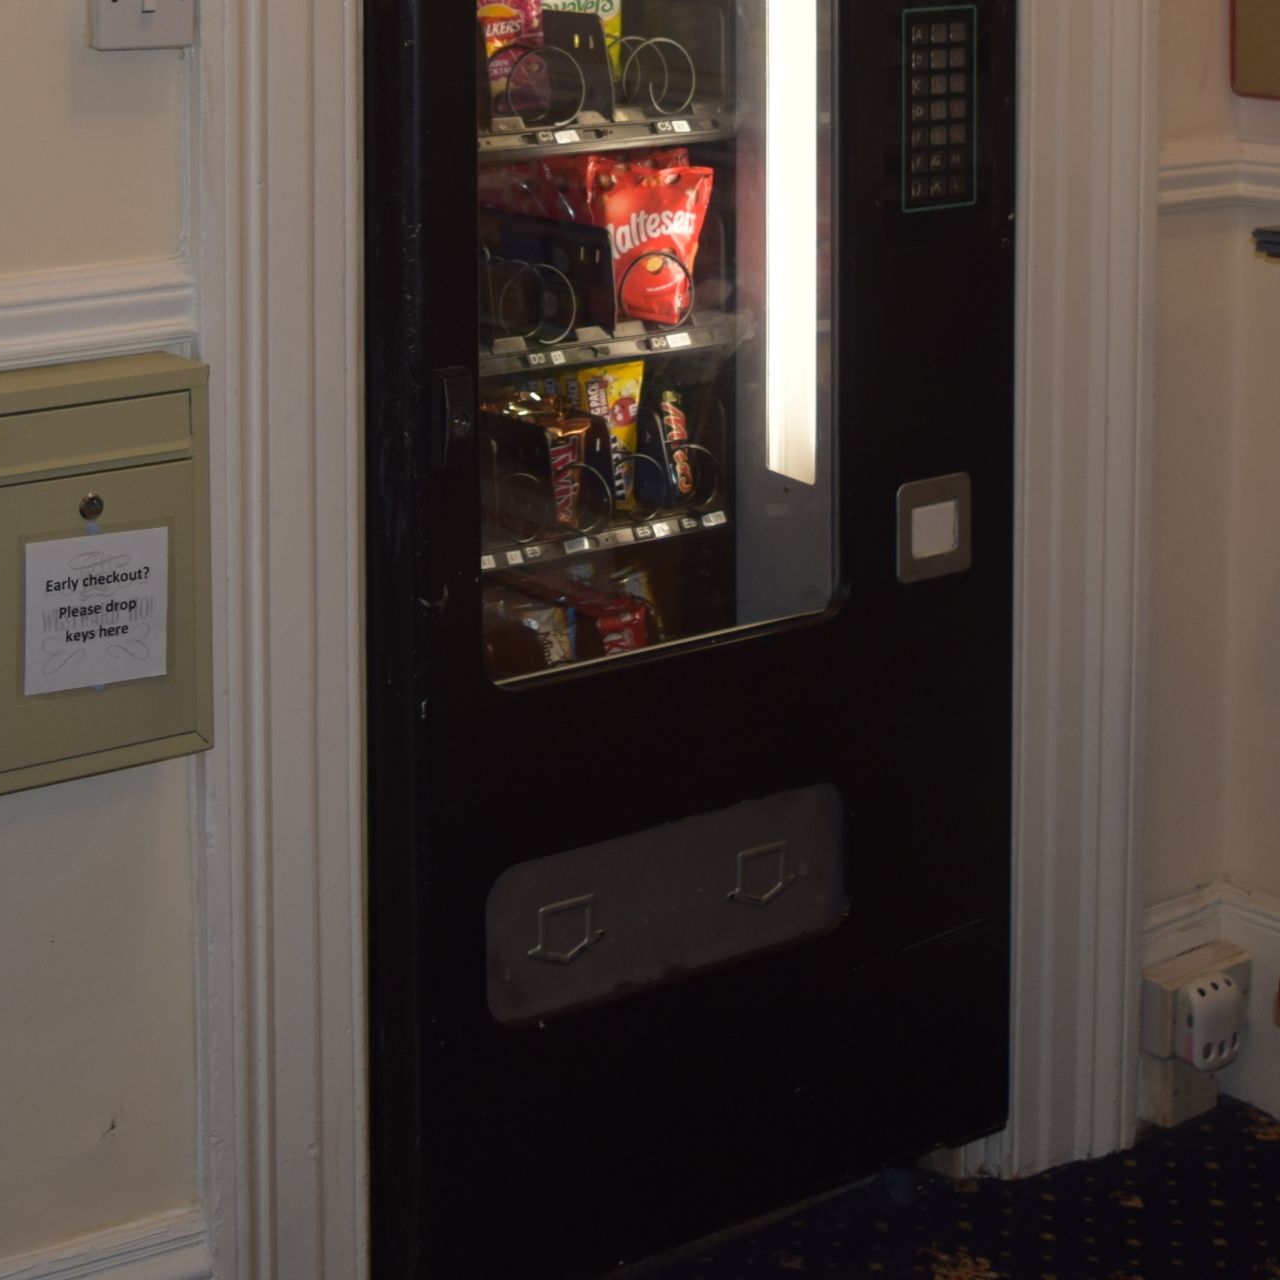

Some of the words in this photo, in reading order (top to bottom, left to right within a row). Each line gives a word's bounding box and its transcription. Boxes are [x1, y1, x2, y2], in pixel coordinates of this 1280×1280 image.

[484, 19, 522, 38] LKERS
[657, 120, 673, 131] C5
[651, 337, 667, 347] D5
[530, 353, 545, 364] D3
[550, 436, 580, 522] Twix
[45, 576, 80, 593] Early
[82, 566, 150, 589] checkout?
[59, 603, 101, 620] Please
[105, 598, 137, 614] drop
[65, 629, 96, 644] keys
[99, 623, 129, 638] here
